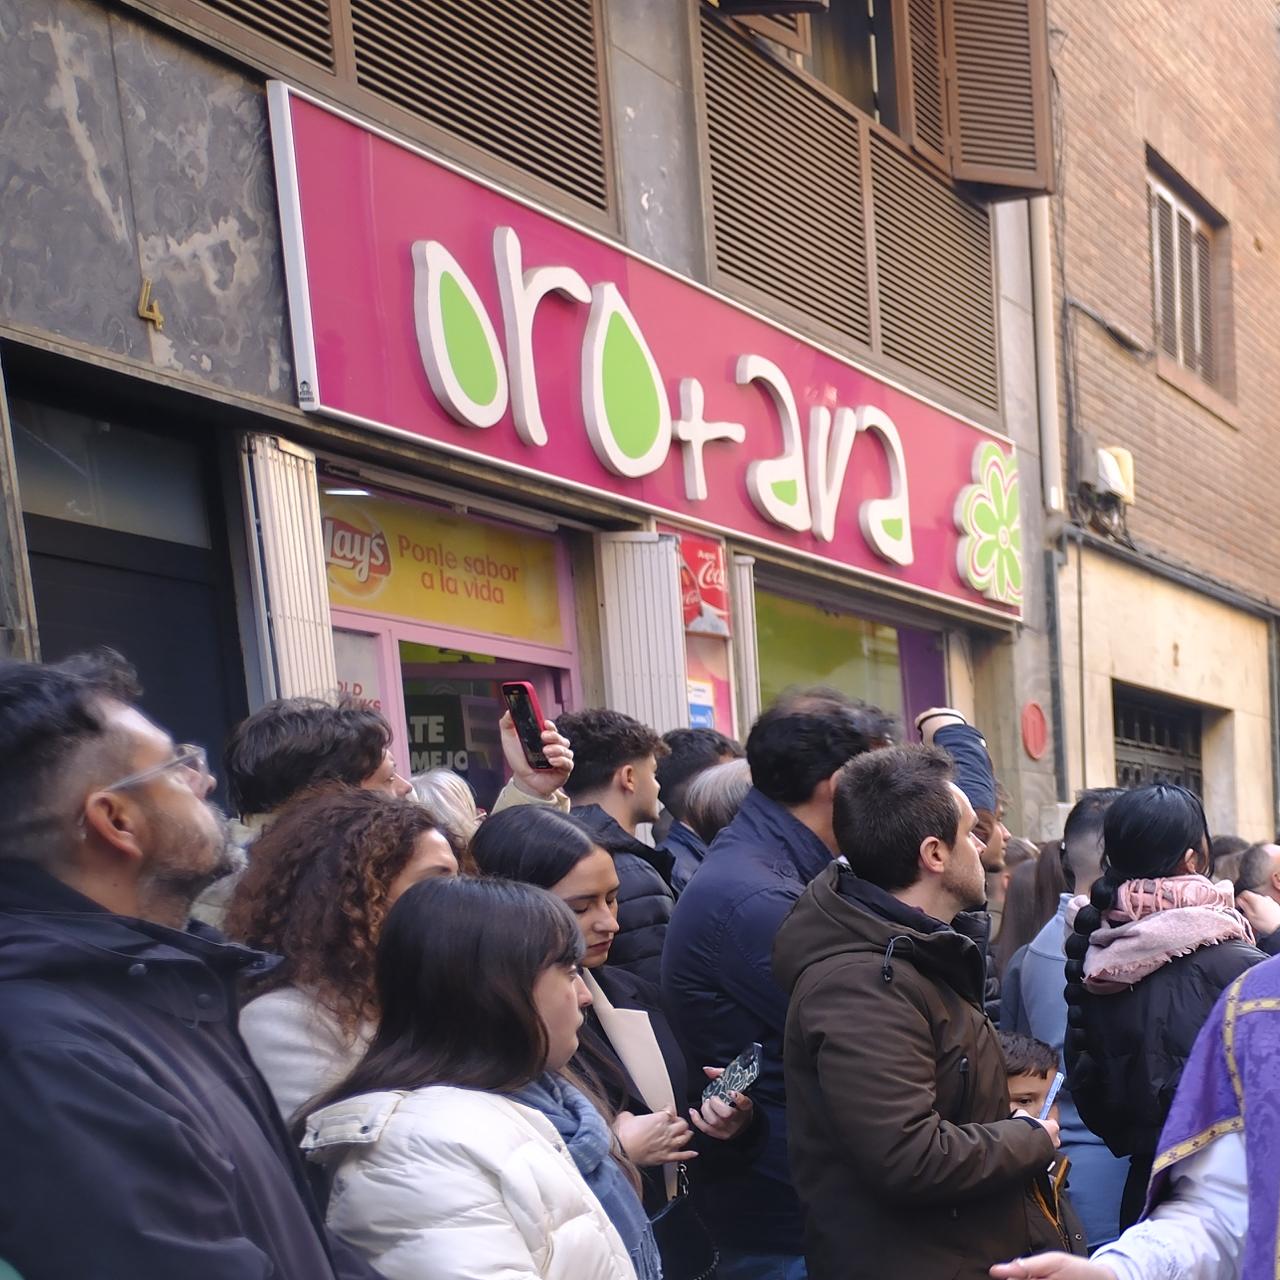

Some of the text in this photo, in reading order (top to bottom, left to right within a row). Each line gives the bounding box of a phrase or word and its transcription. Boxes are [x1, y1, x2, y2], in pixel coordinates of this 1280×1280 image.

[138, 279, 163, 332] 4
[398, 534, 519, 583] Ponle sabor
[421, 569, 504, 605] a la vida
